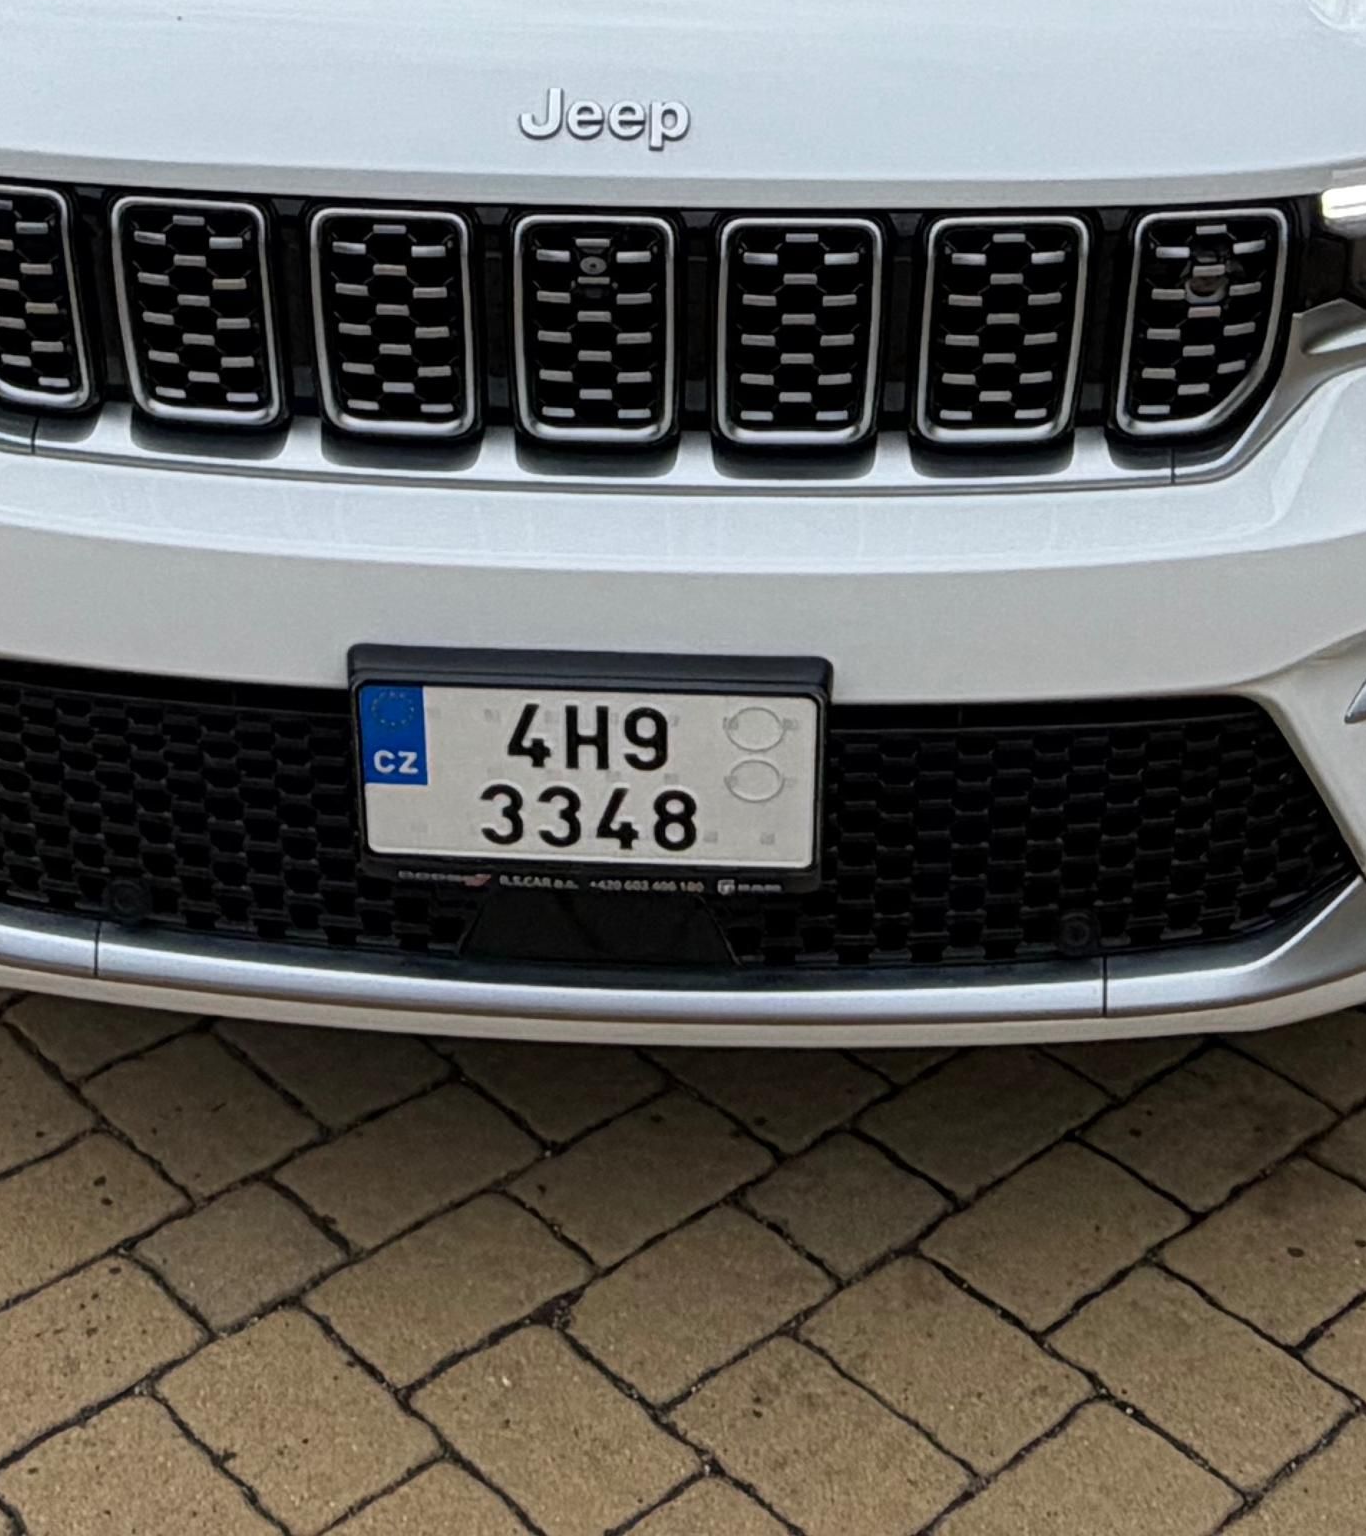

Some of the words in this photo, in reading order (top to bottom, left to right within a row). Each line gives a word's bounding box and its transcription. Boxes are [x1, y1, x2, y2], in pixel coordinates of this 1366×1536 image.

[519, 87, 690, 152] Jeep
[374, 750, 419, 774] CZ
[507, 703, 668, 772] 4H9
[480, 783, 698, 852] 3348
